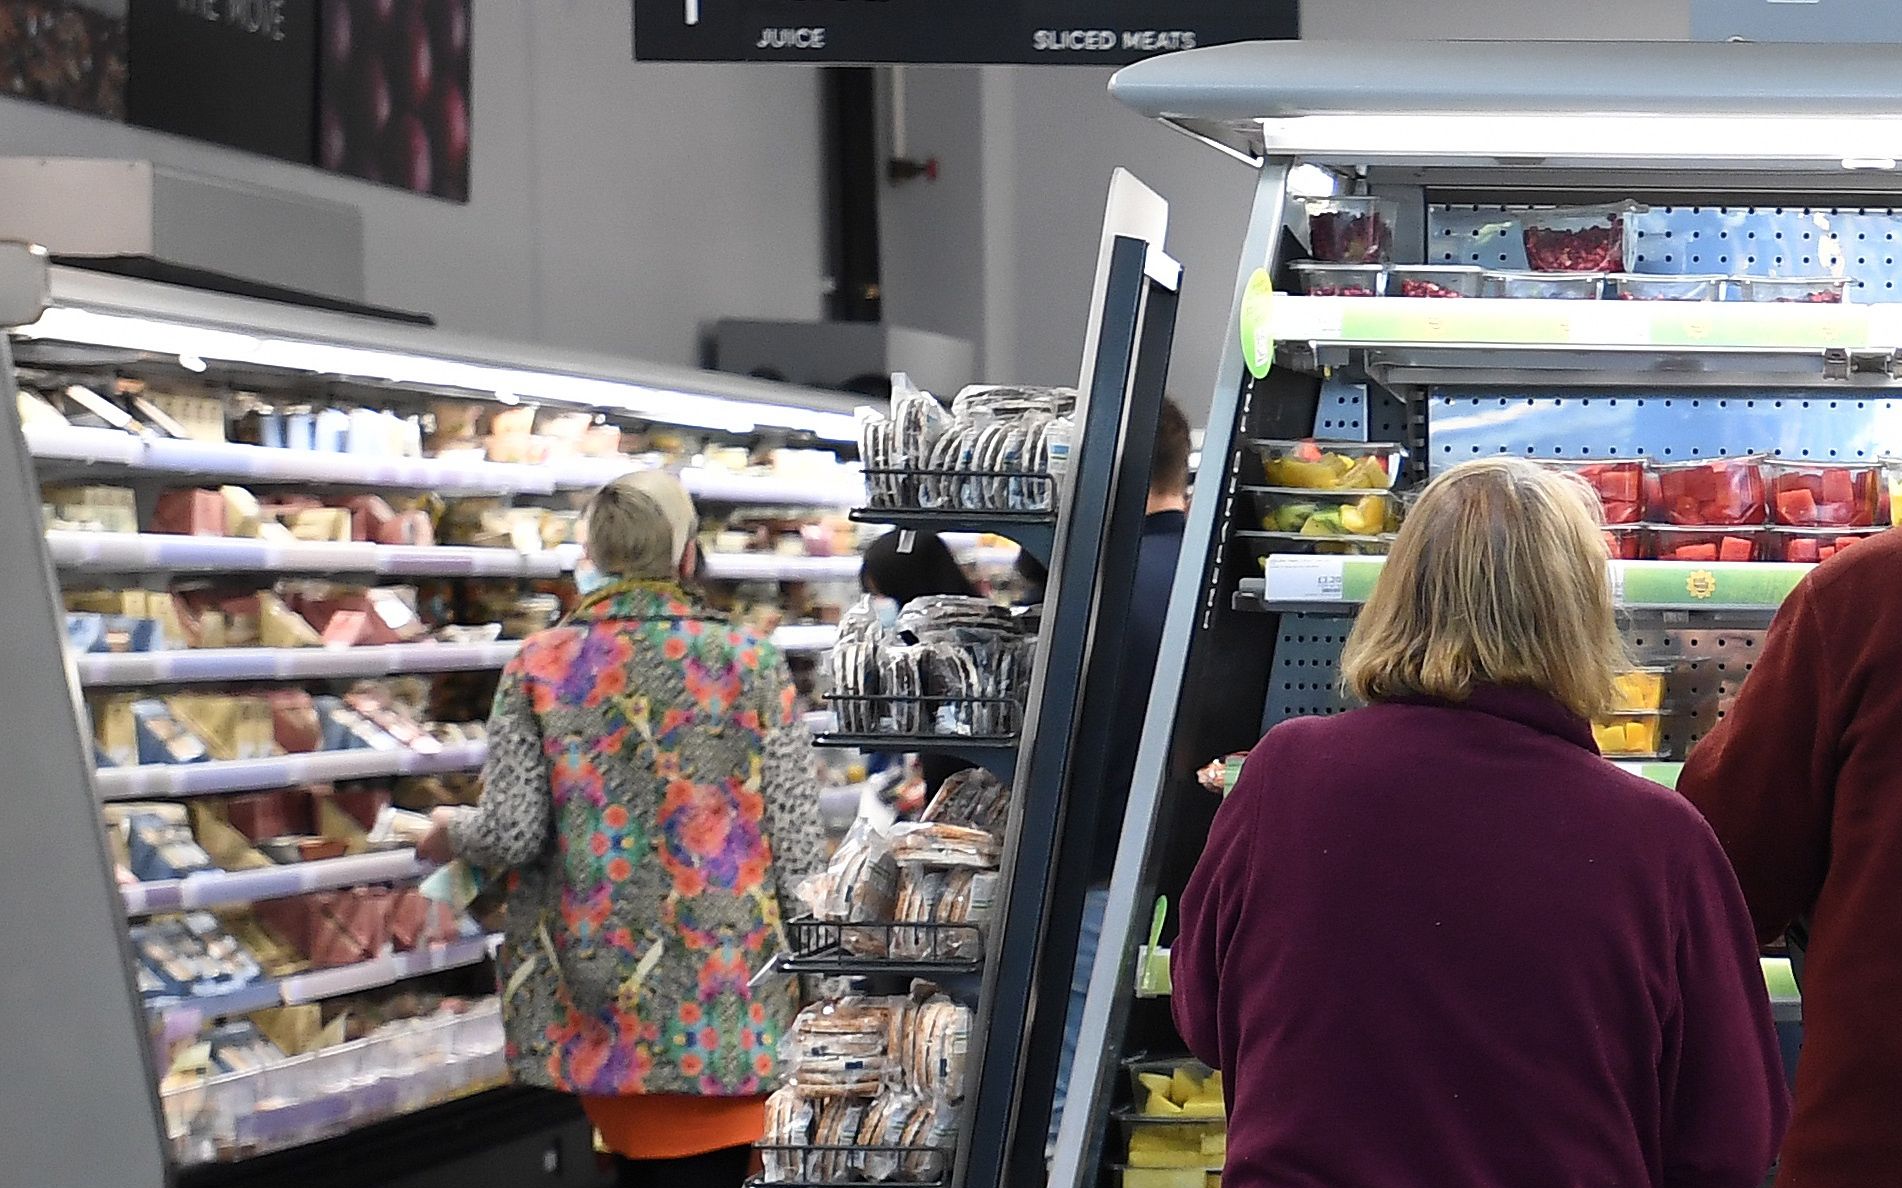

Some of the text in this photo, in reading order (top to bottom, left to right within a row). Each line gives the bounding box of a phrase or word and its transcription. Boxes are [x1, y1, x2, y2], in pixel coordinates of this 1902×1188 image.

[756, 27, 827, 49] JUICE
[1032, 29, 1198, 51] SLICED MEATS
